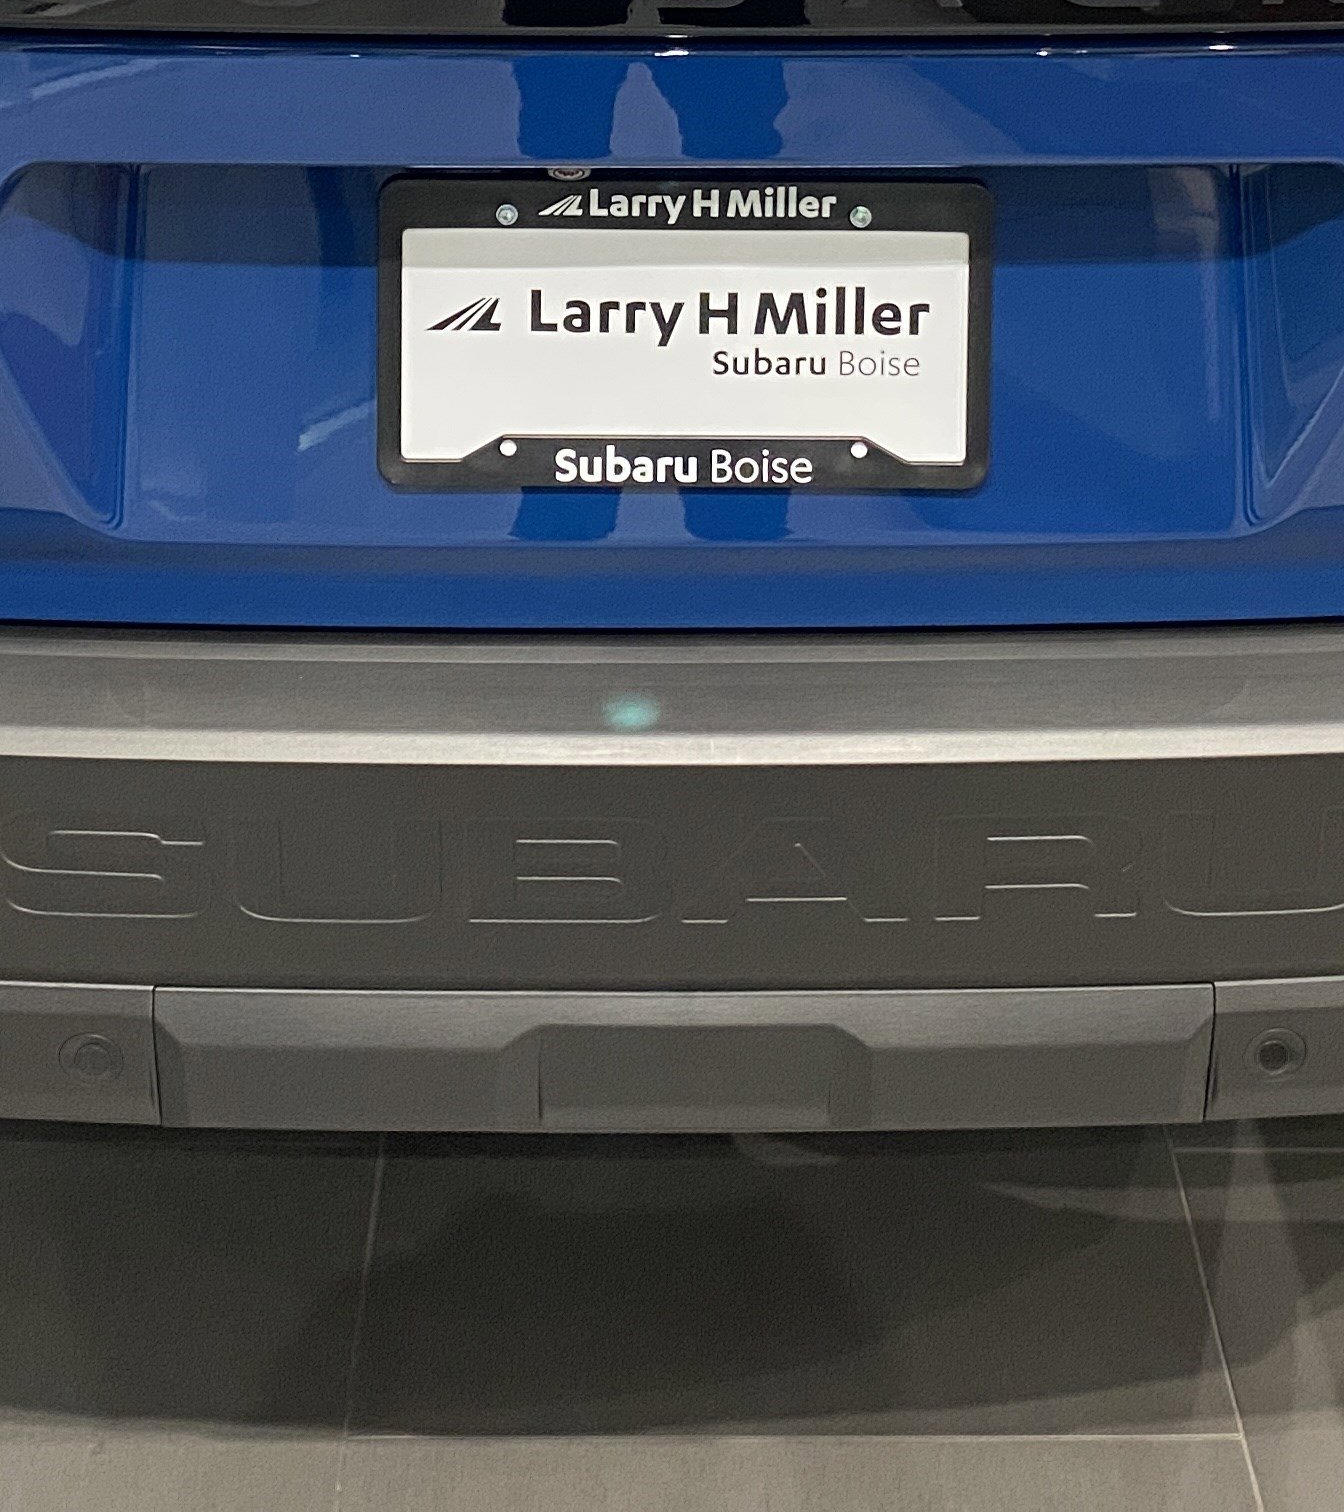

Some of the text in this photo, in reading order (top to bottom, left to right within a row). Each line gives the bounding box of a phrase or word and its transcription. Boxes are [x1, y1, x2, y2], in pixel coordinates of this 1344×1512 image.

[589, 185, 837, 225] Larry H Miller
[531, 286, 930, 347] Larry H Miller
[712, 347, 920, 376] Subaru Boise
[555, 444, 813, 484] Subaru Boise
